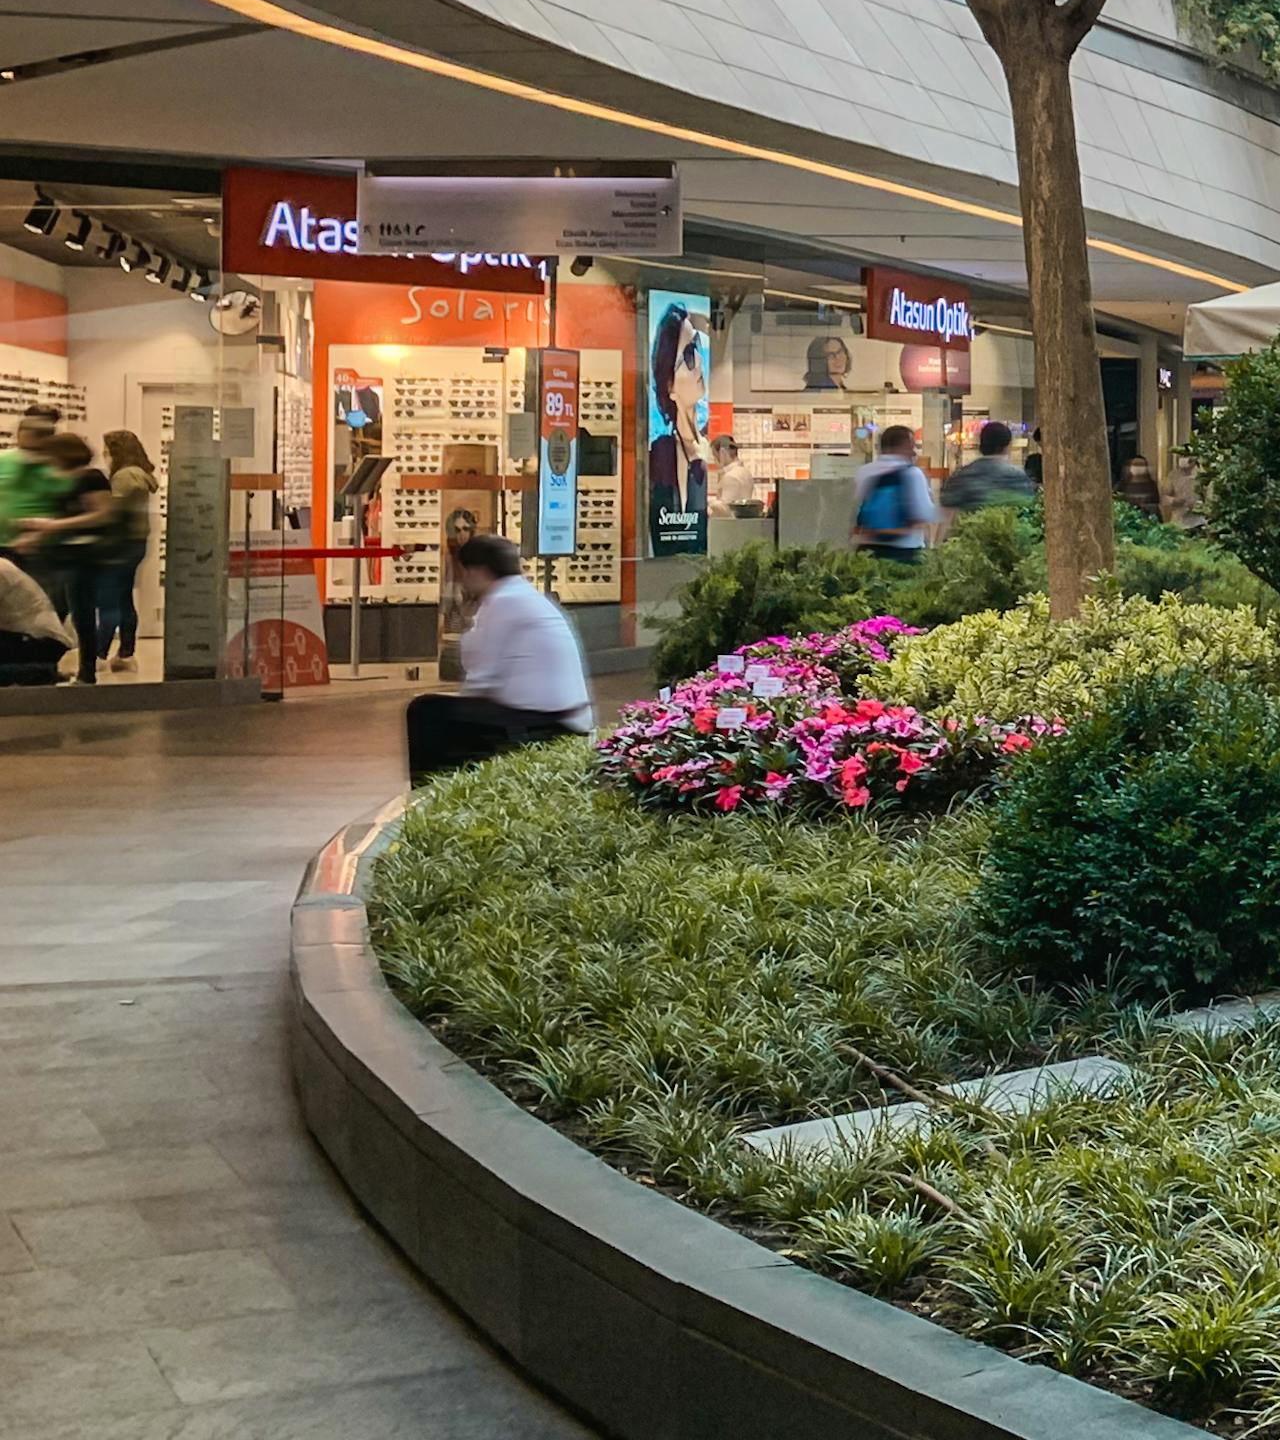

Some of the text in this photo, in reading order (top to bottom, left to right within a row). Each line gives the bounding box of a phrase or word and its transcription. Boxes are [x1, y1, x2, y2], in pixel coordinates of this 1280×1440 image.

[889, 287, 970, 343] Atasun Optik
[545, 392, 564, 417] 89
